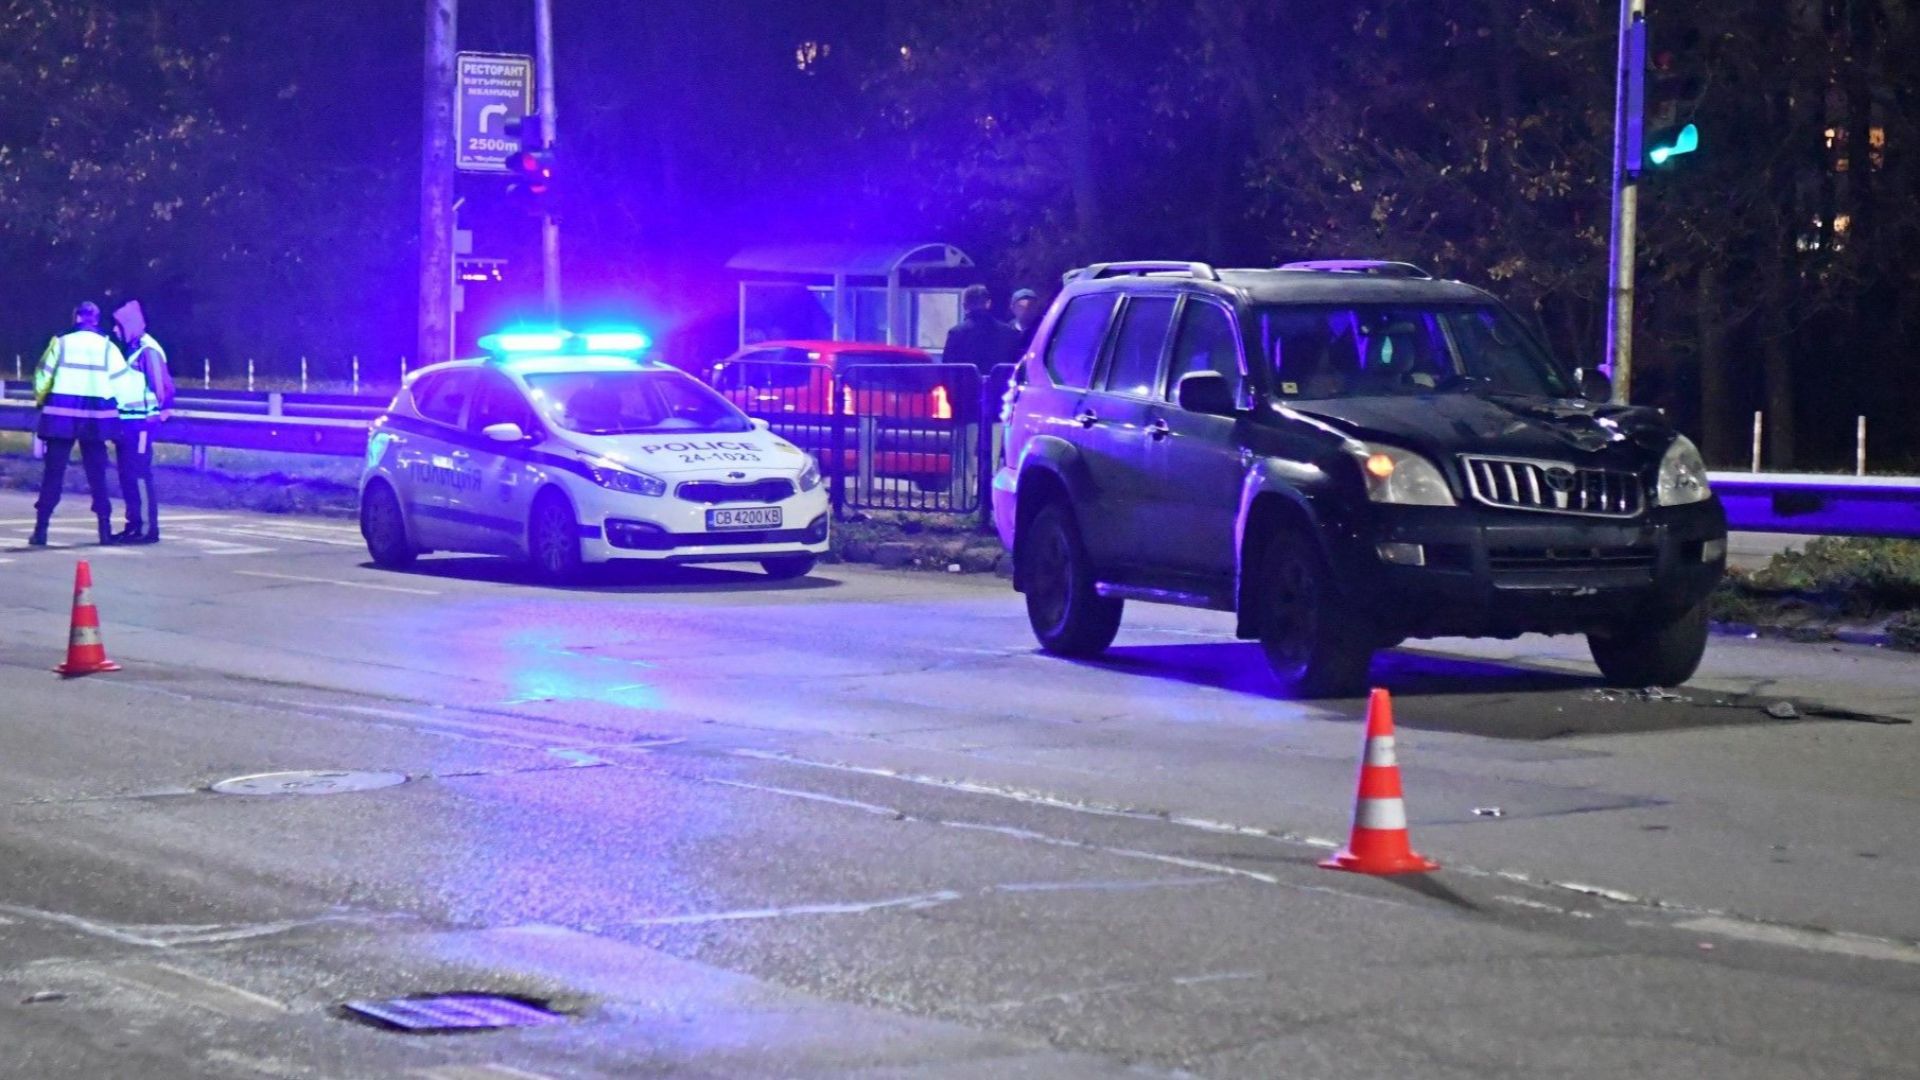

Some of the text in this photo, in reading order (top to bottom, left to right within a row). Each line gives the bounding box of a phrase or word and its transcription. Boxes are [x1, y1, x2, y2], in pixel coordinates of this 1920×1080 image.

[464, 64, 525, 76] РЕСТОРАНТ
[469, 138, 518, 152] 2500m
[641, 441, 763, 454] POLICE
[679, 452, 761, 464] 24-1023
[716, 509, 779, 524] CB 4200 KB
